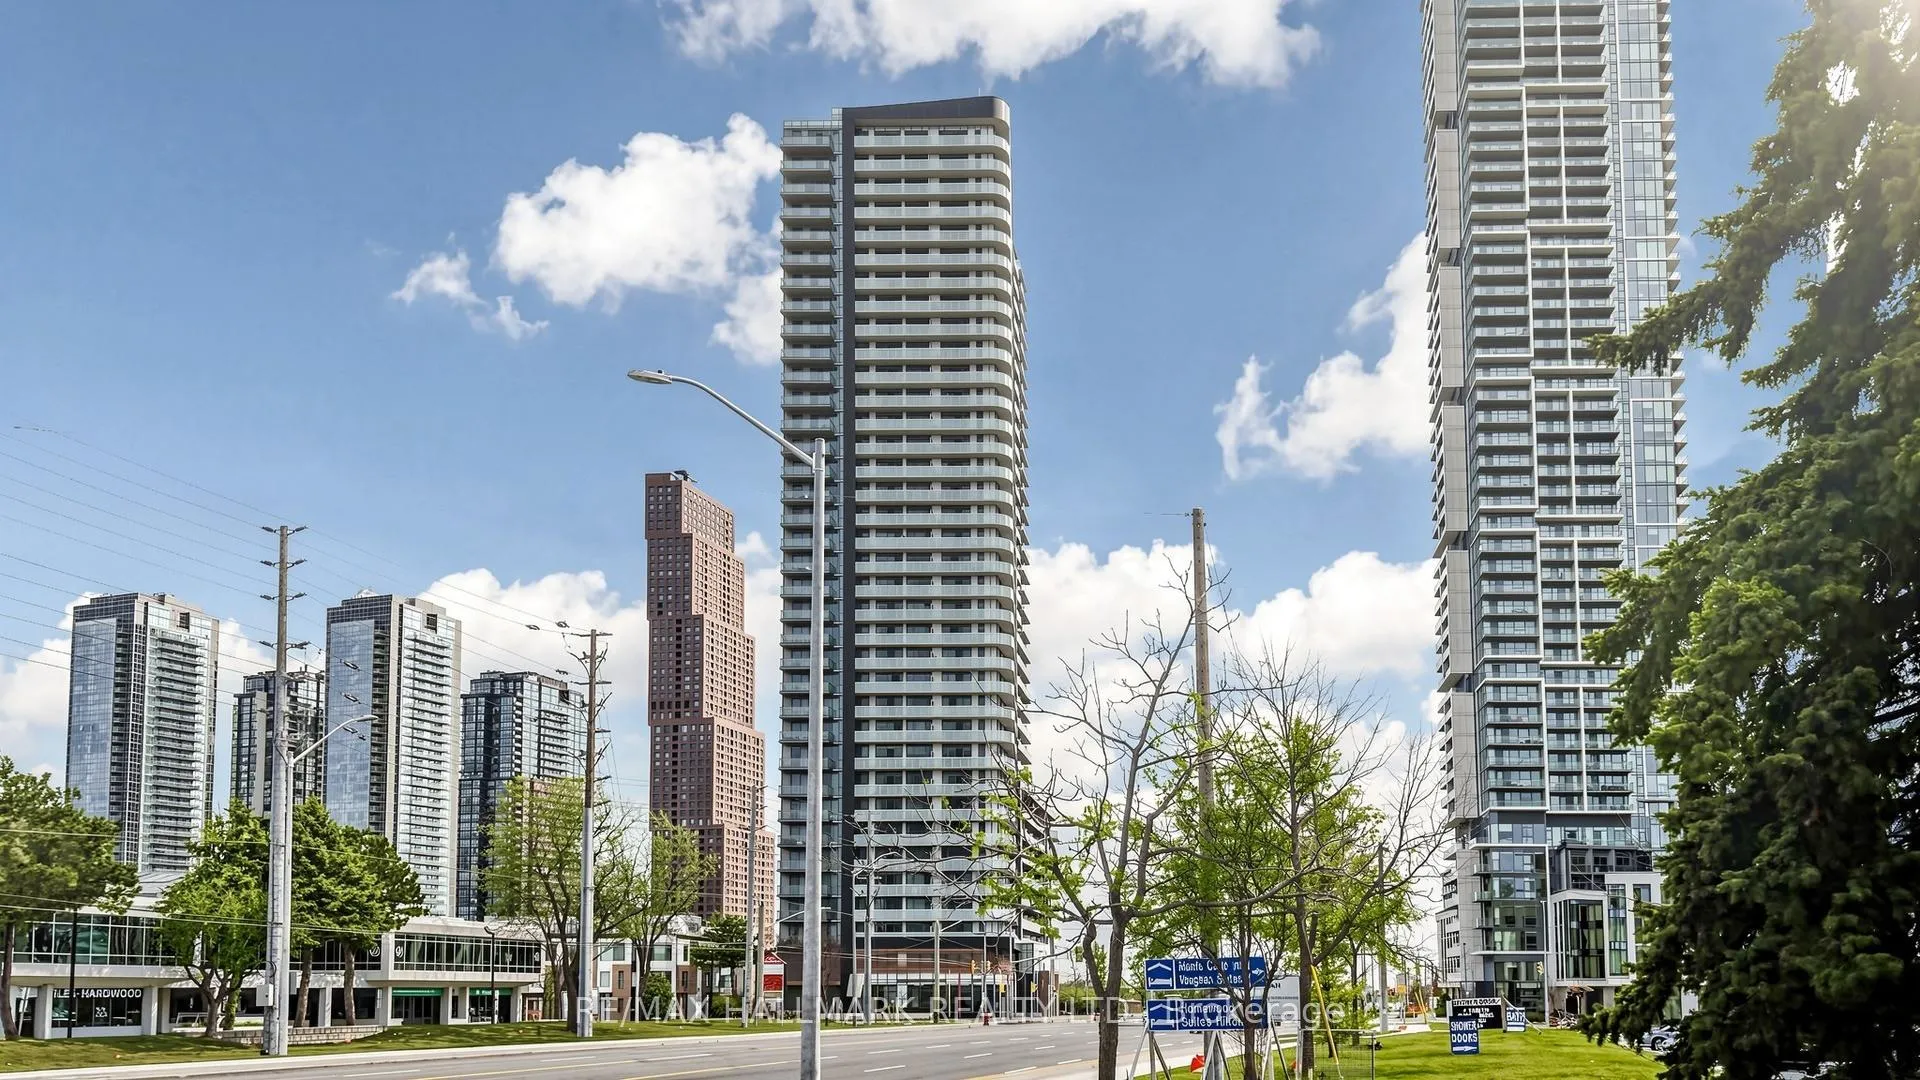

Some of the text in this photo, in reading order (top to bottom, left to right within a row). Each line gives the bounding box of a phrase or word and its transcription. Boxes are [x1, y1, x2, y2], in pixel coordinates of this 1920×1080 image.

[1206, 960, 1229, 972] Calo
[1181, 1002, 1236, 1014] Homewoo
[1450, 1021, 1477, 1031] SHOWER
[1451, 1032, 1478, 1043] DOORS
